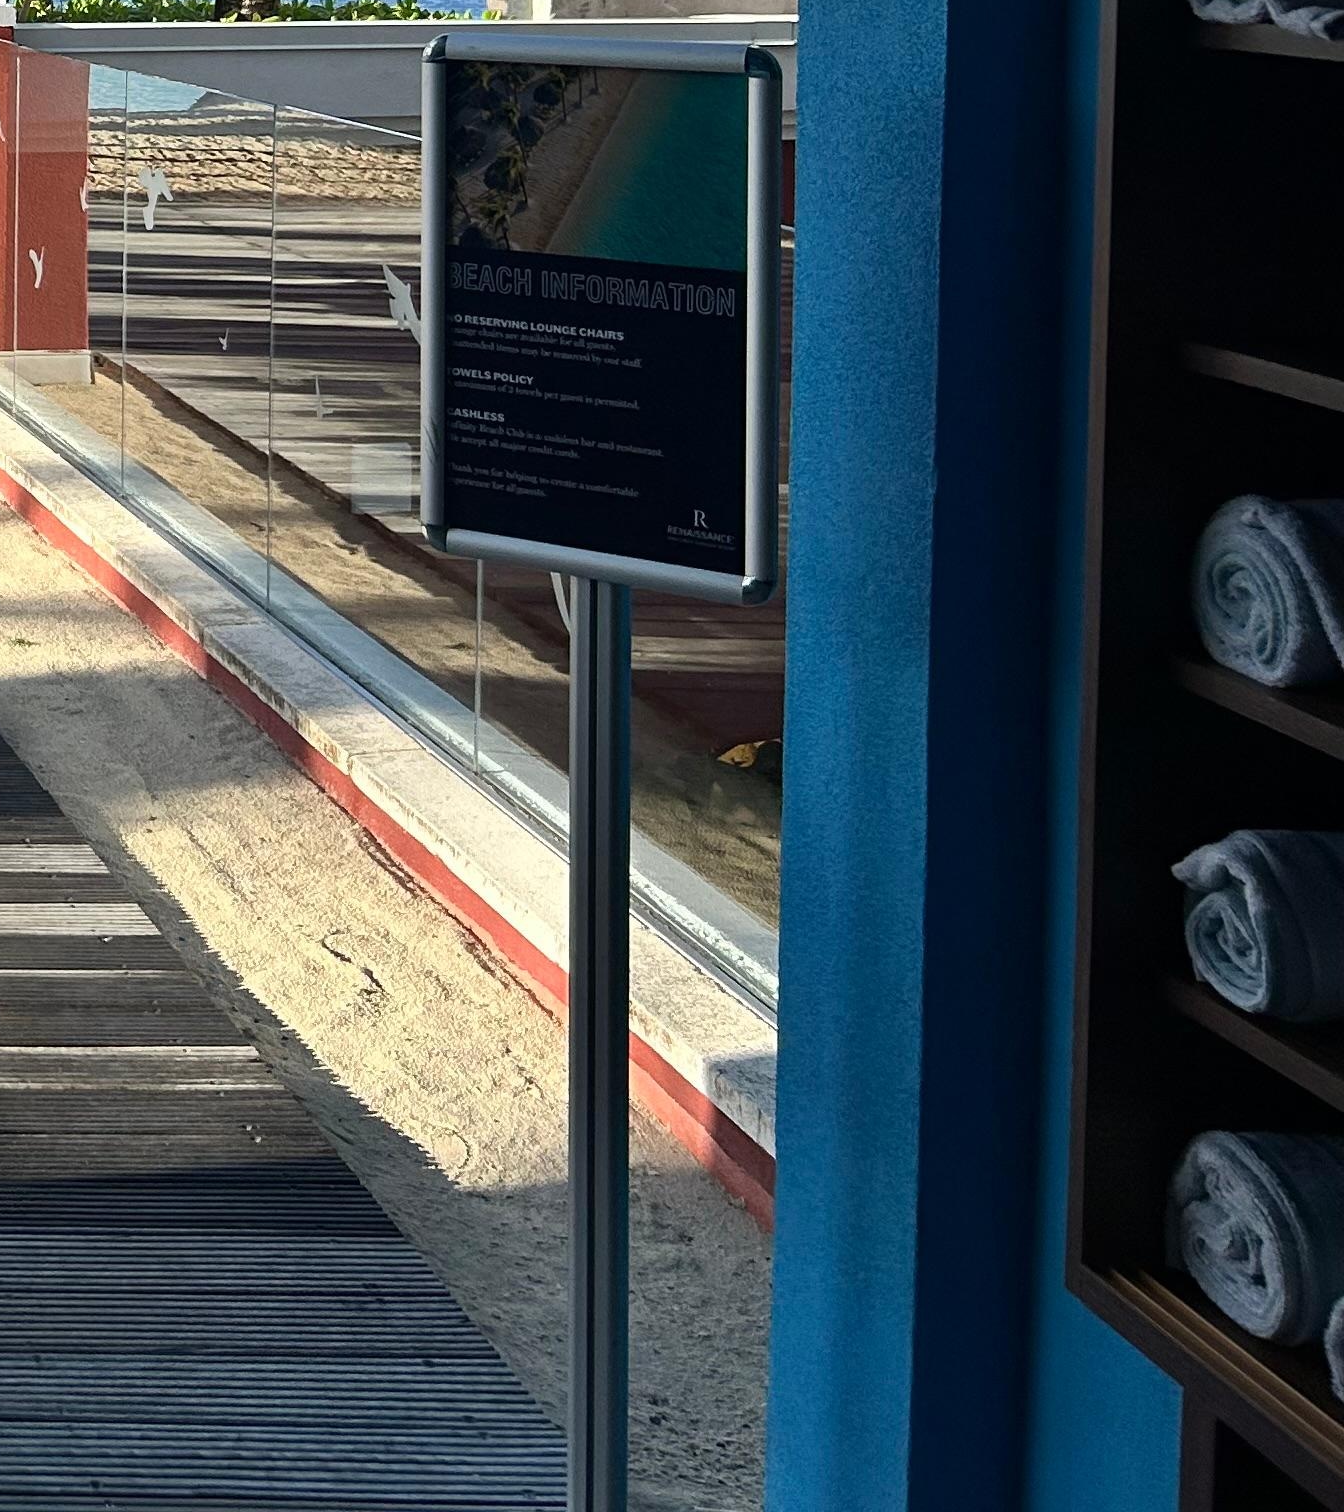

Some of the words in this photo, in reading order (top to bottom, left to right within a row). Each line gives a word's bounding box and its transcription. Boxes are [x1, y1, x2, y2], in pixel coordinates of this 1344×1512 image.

[447, 262, 531, 296] BEACH
[541, 270, 736, 317] INFORMATION
[464, 315, 529, 330] RESERVING
[530, 322, 577, 336] LOUNGE
[579, 327, 625, 341] CHAIRS
[449, 328, 477, 336] ounge
[559, 336, 572, 346] for
[540, 348, 552, 357] be
[447, 368, 492, 380] TOWELS
[493, 372, 534, 385] POLICY
[543, 391, 558, 401] per
[585, 396, 593, 404] is
[447, 407, 505, 423] CASHLESS
[506, 427, 525, 438] Club
[581, 437, 596, 447] bar
[597, 440, 615, 450] and
[528, 445, 553, 455] credit
[473, 467, 489, 476] you
[490, 467, 504, 477] for
[491, 481, 505, 490] for
[694, 509, 710, 528] R
[667, 524, 736, 544] RENAISSANCE
